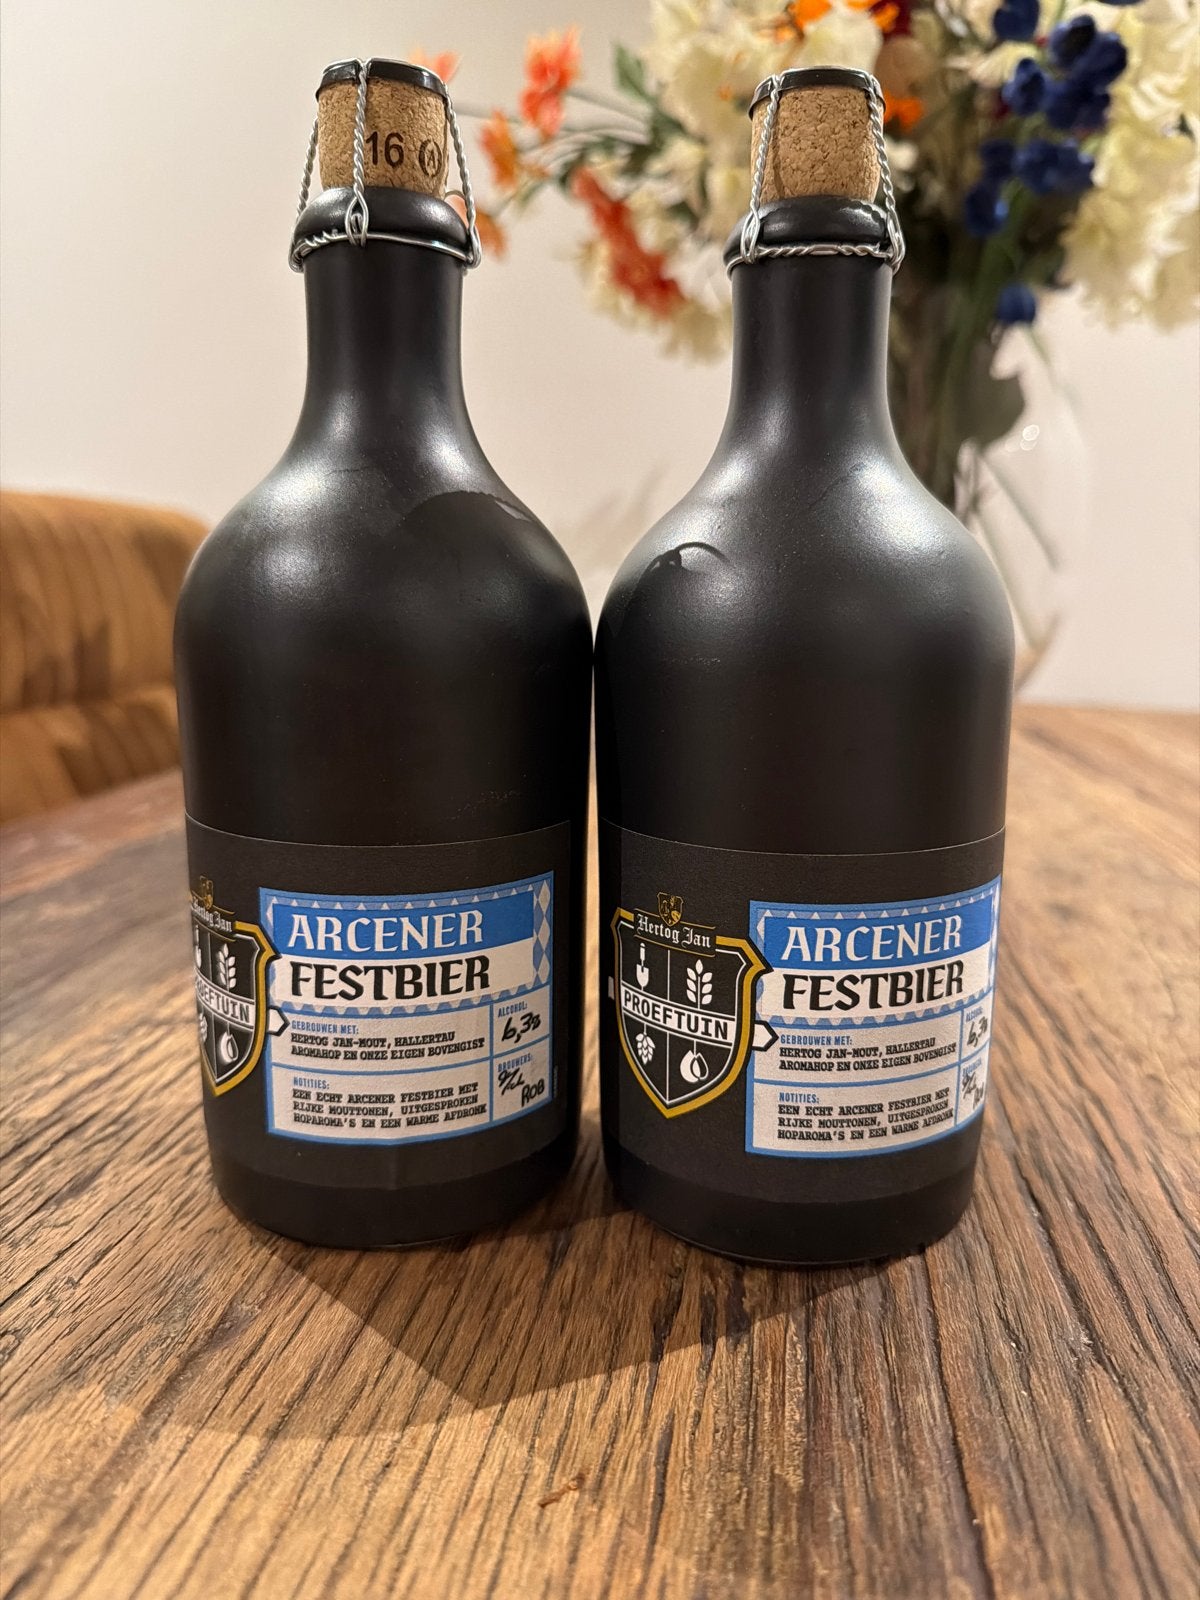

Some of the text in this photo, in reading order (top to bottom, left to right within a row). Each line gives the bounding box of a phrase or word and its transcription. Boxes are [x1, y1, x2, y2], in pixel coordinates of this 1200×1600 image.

[366, 131, 404, 168] 16
[214, 911, 232, 932] Jan
[287, 909, 483, 953] ARCENER
[634, 913, 711, 949] Hertog Jan
[781, 914, 962, 962] ARCENER
[290, 955, 490, 1001] FESTBIER
[783, 959, 964, 1011] FESTBIER
[497, 1000, 528, 1018] ALCOHOL:
[624, 989, 728, 1041] PROEFTUIN
[291, 1020, 359, 1034] GEBROUWEN MET:
[291, 1031, 455, 1049] HERTOG JAN-MOUT, HALLERTAU
[291, 1037, 485, 1060] AROMAHOP EN ONZE EIGEN BOVENGIST
[779, 1037, 936, 1059] HERTOG JAN-MOUT, HALLERTAU
[780, 1034, 853, 1046] GEBROUWEN MET:
[779, 1042, 957, 1072] AROMAHOP EN ONZE EIGEN BOVENGIST
[292, 1082, 479, 1104] EEN ECHT ARCENER FESTBIER MET
[293, 1076, 330, 1090] NOTITIES:
[521, 1078, 546, 1108] ROB
[292, 1094, 479, 1118] RIJKE MOUTTONEN, UITGESPROKEN
[778, 1104, 800, 1115] EEN
[804, 1105, 834, 1116] ECHT
[838, 1103, 884, 1116] ARCENER
[887, 1094, 932, 1112] FESTBIER
[779, 1092, 819, 1104] NOTITIES:
[293, 1103, 488, 1128] HOPAROMA'S EN EEN WARME AFDRONK
[777, 1099, 949, 1128] RIJKE MOUTTONEN, UITGESPROKEN
[777, 1128, 845, 1141] HOPAROMA'S
[849, 1130, 864, 1140] EN
[867, 1127, 888, 1139] EEN
[891, 1120, 920, 1135] WARME
